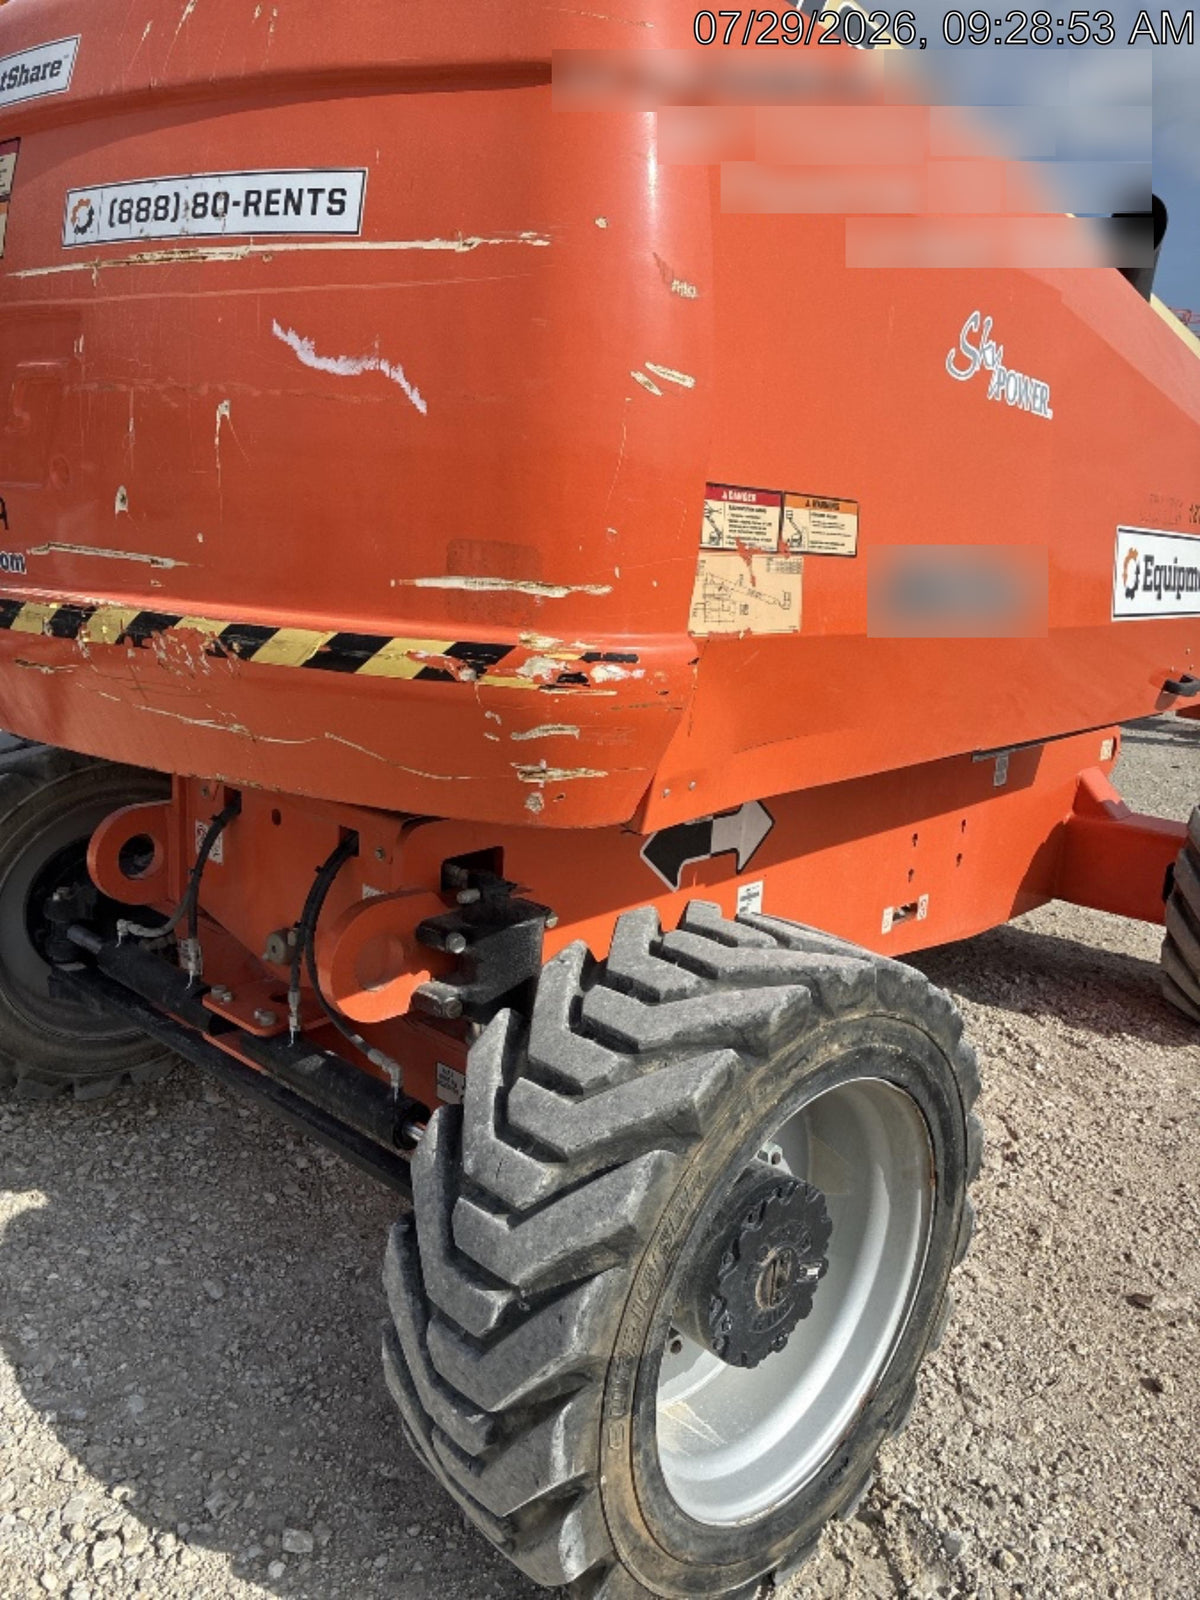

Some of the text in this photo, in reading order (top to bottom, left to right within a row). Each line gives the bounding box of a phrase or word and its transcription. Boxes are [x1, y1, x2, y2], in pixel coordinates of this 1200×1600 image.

[108, 188, 347, 228] (888) 80-RENTS
[993, 366, 1053, 419] POWER
